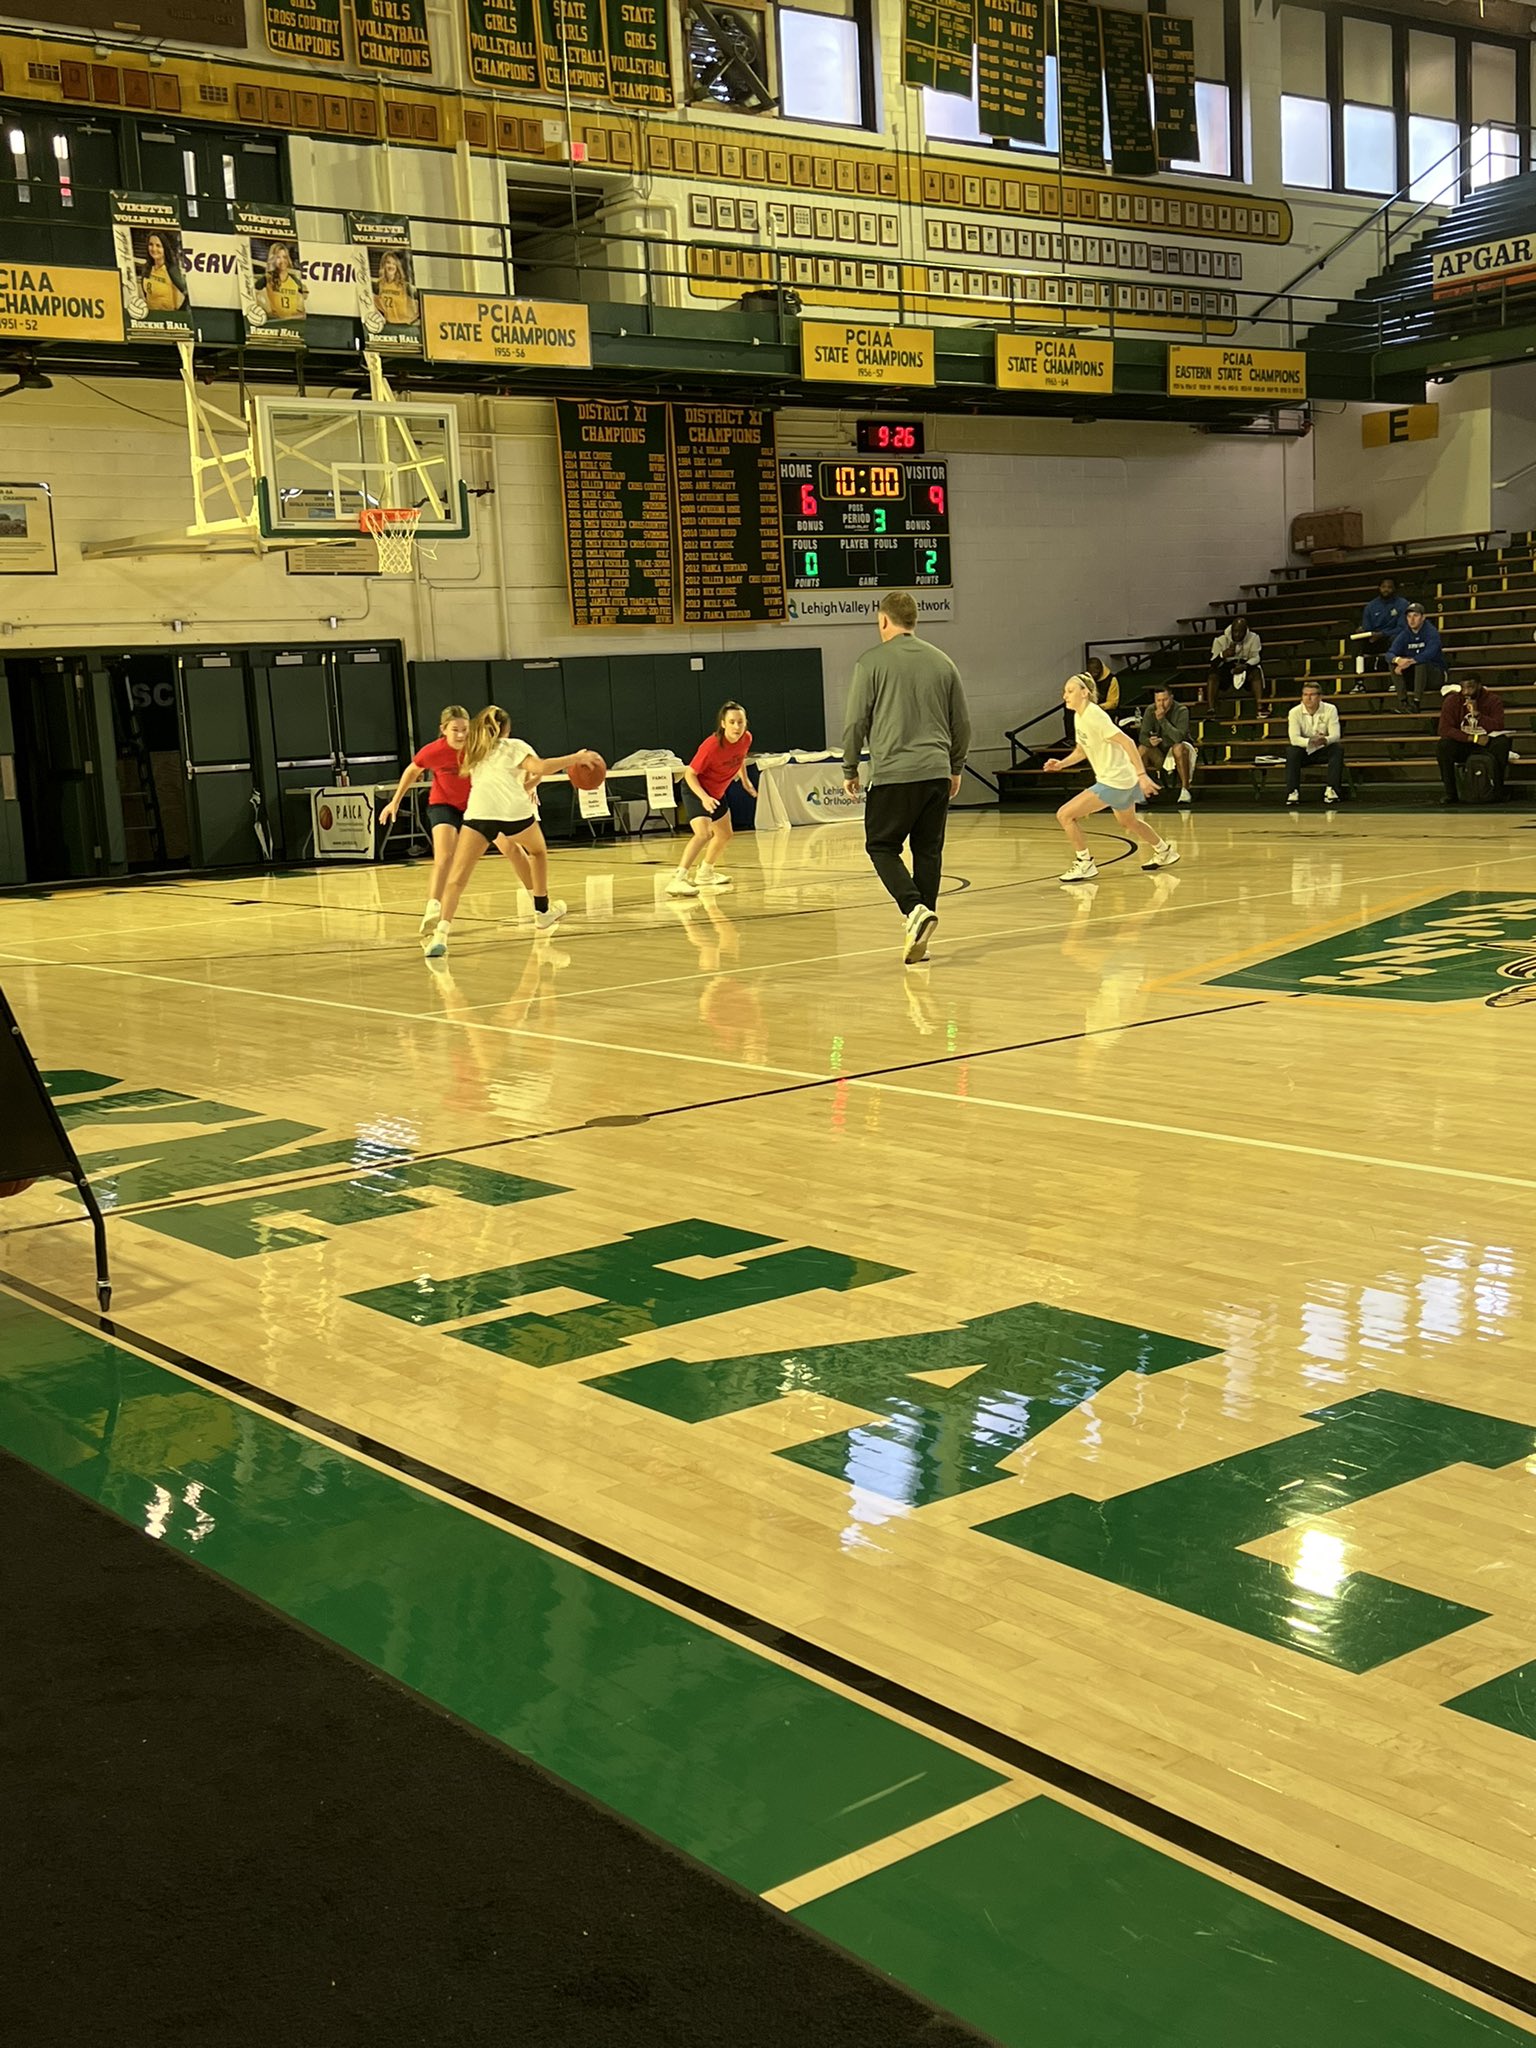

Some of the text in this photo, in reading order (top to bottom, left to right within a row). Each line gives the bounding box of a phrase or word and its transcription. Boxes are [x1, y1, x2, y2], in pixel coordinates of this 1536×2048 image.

[372, 0, 411, 21] GIRLS
[553, 0, 587, 20] STATE
[621, 5, 656, 24] STATE
[268, 8, 339, 35] CROSS COUNTRY
[484, 13, 517, 34] GIRLS
[988, 16, 1003, 33] 100
[1010, 21, 1034, 40] WINS
[357, 19, 428, 45] VOLLEYBALL
[624, 31, 656, 50] GIRLS
[270, 29, 340, 57] CHAMPIONS
[471, 33, 536, 59] VOLLEYBALL
[360, 42, 429, 67] CHAMPIONS
[543, 44, 605, 66] VOLEYBALL
[474, 57, 535, 82] CHAMPIONS
[611, 55, 669, 78] VOLLEYBALL
[612, 82, 672, 103] CHAMPIONS
[117, 202, 174, 215] VIKETTE
[113, 214, 180, 225] VOLLEYBALL
[238, 213, 291, 226] VIKETTE
[235, 224, 297, 237] VOLLEYBALL
[355, 223, 405, 234] VIKETTE
[352, 234, 410, 245] VOLLEYBALL
[181, 248, 238, 275] SERV
[1437, 238, 1534, 279] APGAR
[281, 296, 291, 309] 13
[478, 303, 538, 325] PCIAA
[166, 320, 190, 331] HALL
[280, 327, 300, 338] HALL
[399, 334, 419, 344] HALL
[439, 322, 576, 347] STATE CHAMPIONS
[846, 328, 893, 348] PCIAA
[814, 345, 923, 368] STATE CHAMPIONS
[1035, 341, 1077, 358] PCIAA
[1007, 356, 1104, 377] STATE CHAMPIONS
[1223, 352, 1253, 366] PCIAA
[1175, 366, 1300, 384] EASTERN STATE CHAMPIONS
[577, 403, 647, 422] DISTRICT XI
[685, 408, 763, 425] DISTRICT XI
[581, 426, 646, 443] CHAMPIONS
[1389, 409, 1409, 443] E
[688, 427, 761, 444] CHAMPIONS
[878, 425, 915, 448] 9:26
[780, 463, 813, 478] HOME
[906, 466, 945, 480] VISITOR
[835, 467, 899, 496] 10:00
[801, 483, 818, 515] 6
[929, 485, 944, 514] 9
[848, 504, 864, 512] POSS
[797, 520, 824, 531] BONUS
[842, 513, 871, 524] PERIOD
[874, 508, 886, 533] 3
[905, 520, 931, 531] BONUS
[792, 539, 818, 550] FOULS
[840, 539, 898, 549] PLAYER FOULS
[914, 538, 937, 548] FOULS
[805, 552, 818, 576] 0
[925, 550, 938, 574] 2
[1499, 566, 1508, 575] 11
[795, 578, 820, 588] POINTS
[858, 577, 878, 586] GAME
[915, 575, 939, 585] POINTS
[1468, 584, 1478, 593] 10
[801, 602, 837, 616] Lehigh
[838, 600, 870, 616] Valley
[917, 599, 950, 611] etwork
[1438, 603, 1443, 612] 9
[1338, 661, 1344, 670] 6
[1231, 725, 1237, 734] 3
[823, 786, 846, 796] Lehig
[336, 805, 362, 819] PAICA
